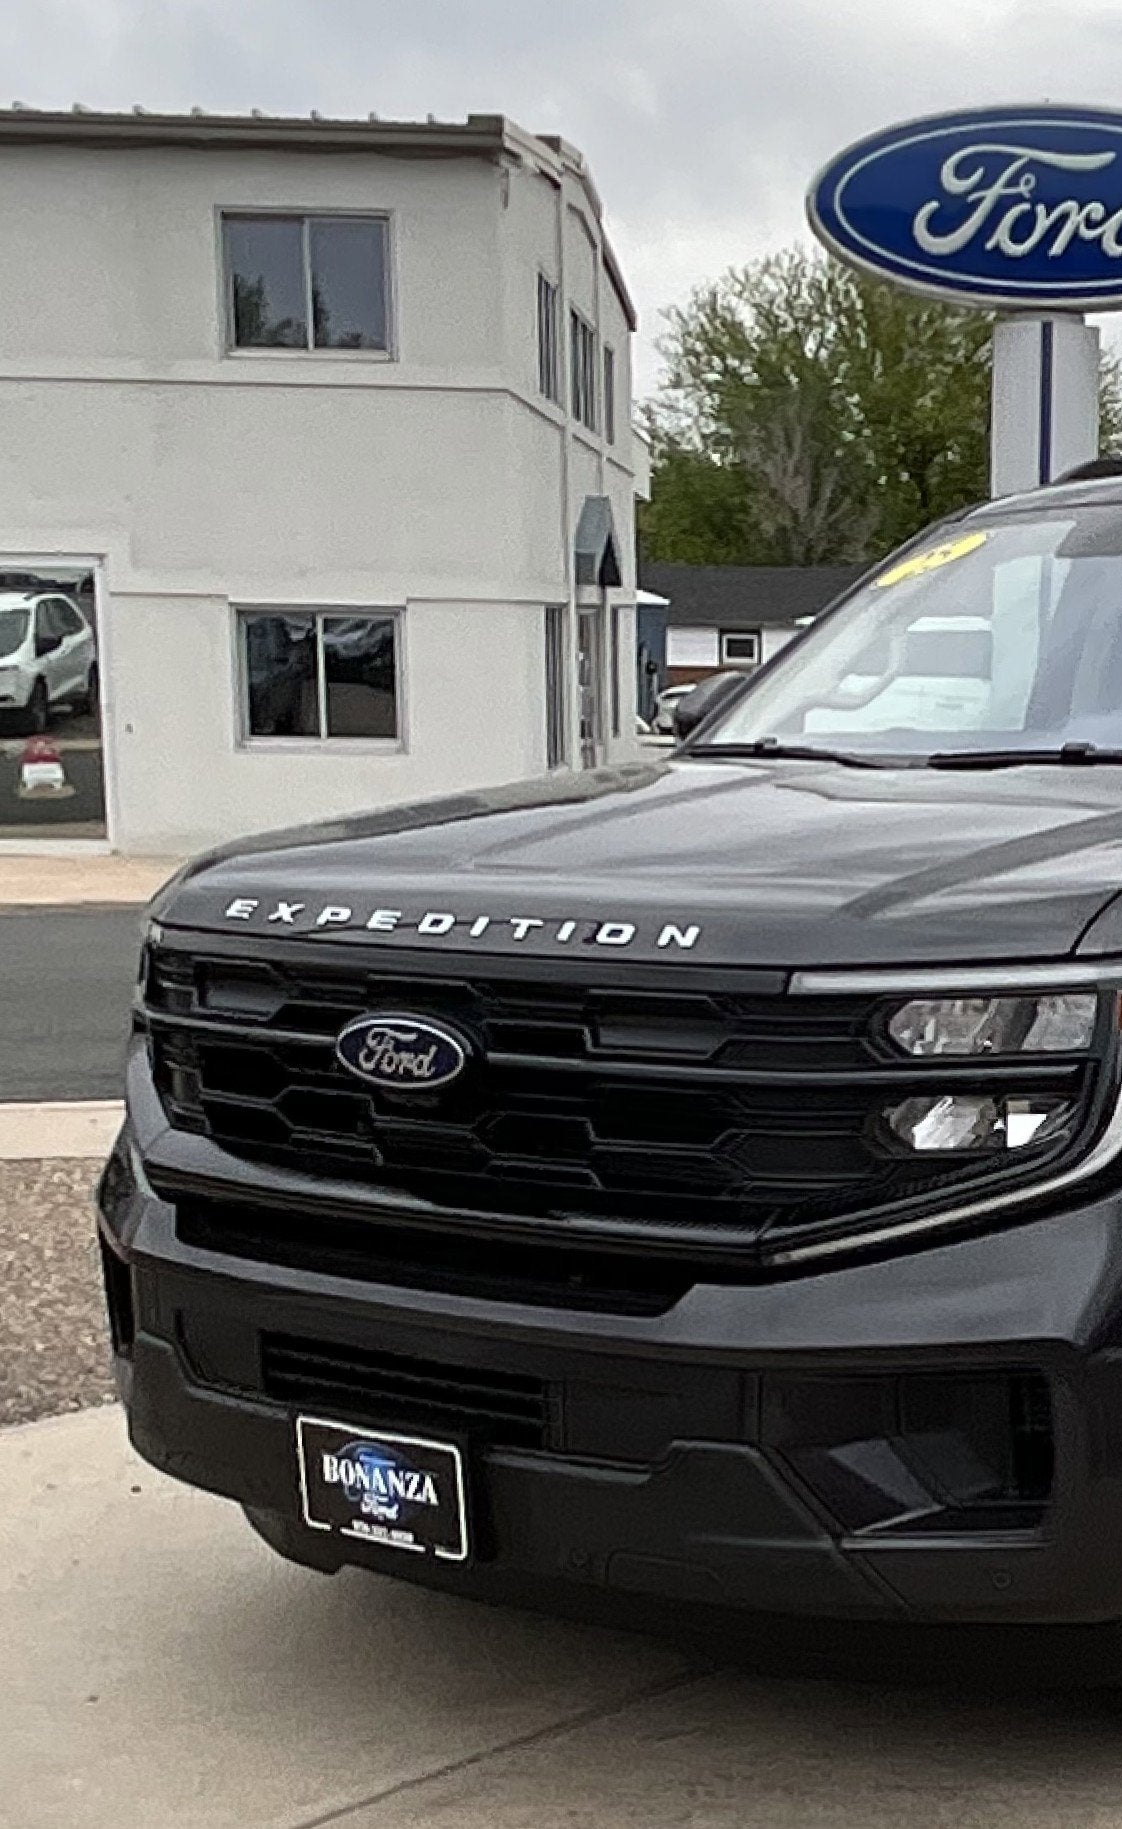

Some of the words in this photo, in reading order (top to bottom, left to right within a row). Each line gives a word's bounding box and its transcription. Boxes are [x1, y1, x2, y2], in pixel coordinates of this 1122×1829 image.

[224, 898, 701, 949] EXPEDITION
[359, 1027, 438, 1077] Ford
[322, 1454, 440, 1507] BONANZA
